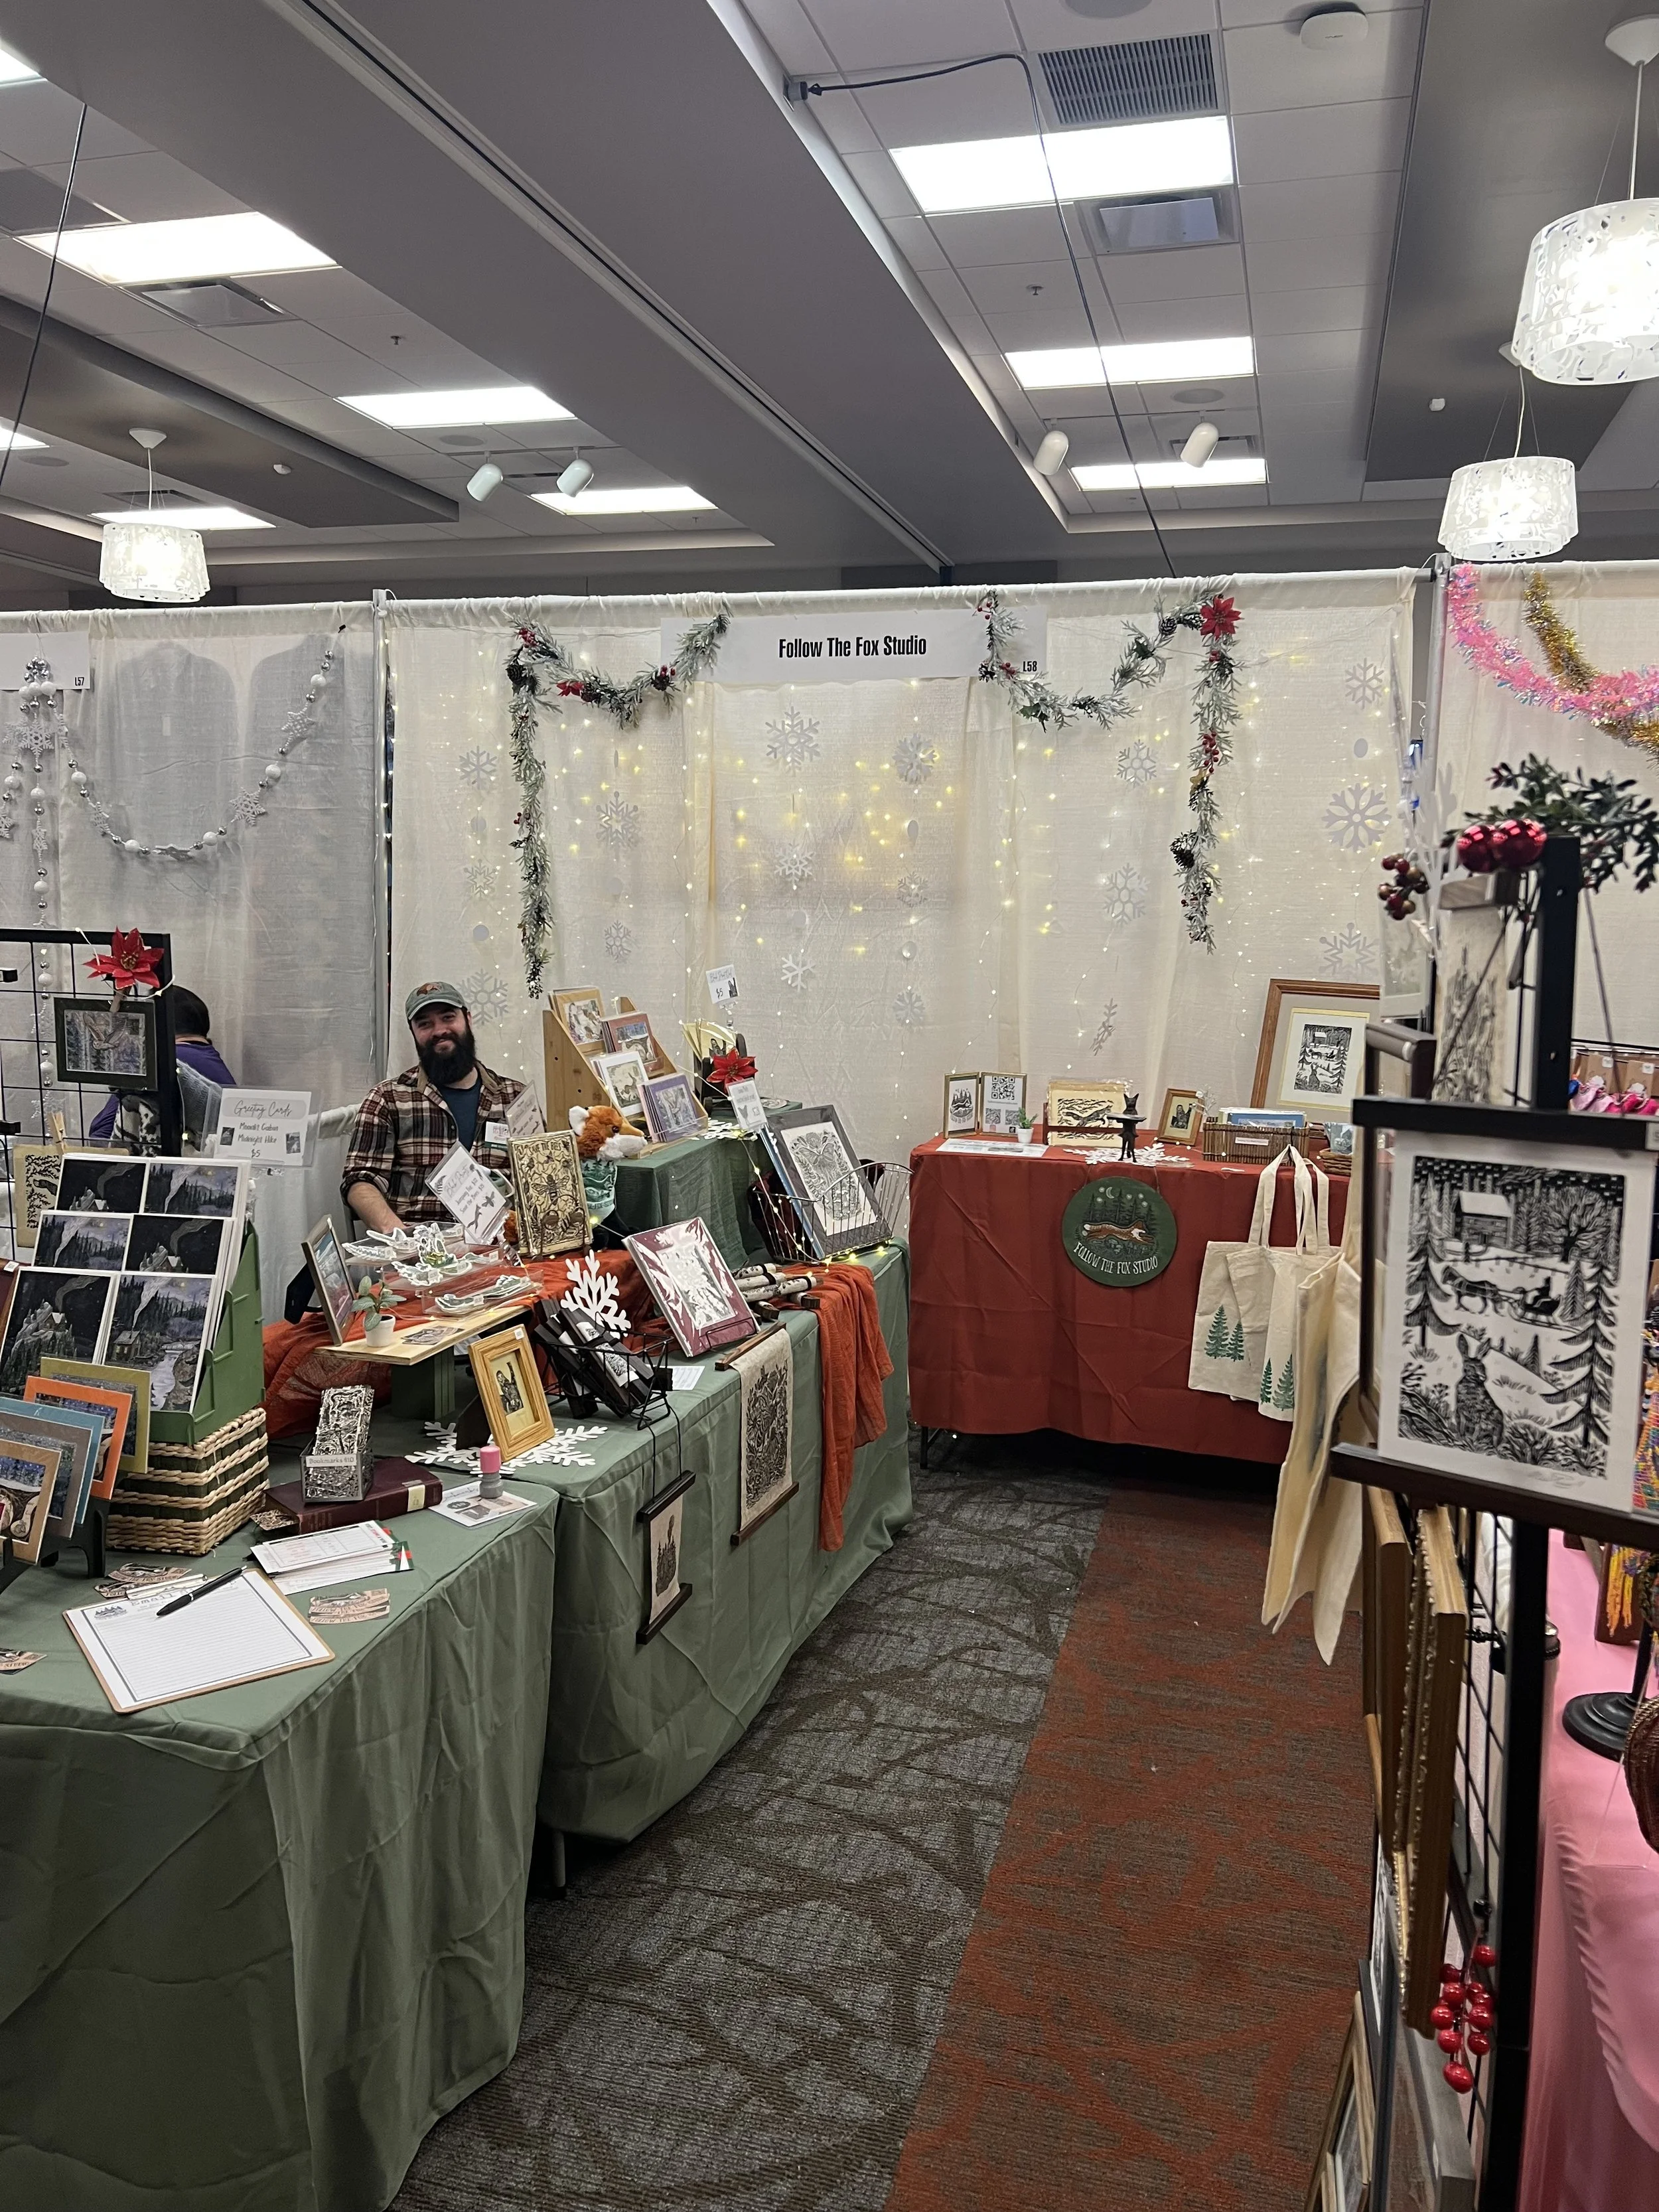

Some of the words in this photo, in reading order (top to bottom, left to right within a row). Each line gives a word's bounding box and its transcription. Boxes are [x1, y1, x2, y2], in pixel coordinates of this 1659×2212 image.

[779, 638, 823, 658] Follow
[827, 637, 851, 656] The
[856, 636, 879, 656] Fox
[883, 635, 926, 656] Studio
[1023, 661, 1037, 672] L58
[74, 677, 84, 686] L57
[234, 1100, 265, 1120] Greeting
[268, 1102, 292, 1117] Cards
[252, 1149, 261, 1158] $5
[1073, 1242, 1101, 1268] FOLLOW
[1101, 1258, 1116, 1274] THE
[1117, 1262, 1131, 1274] FOX
[1133, 1256, 1158, 1274] STUDIO
